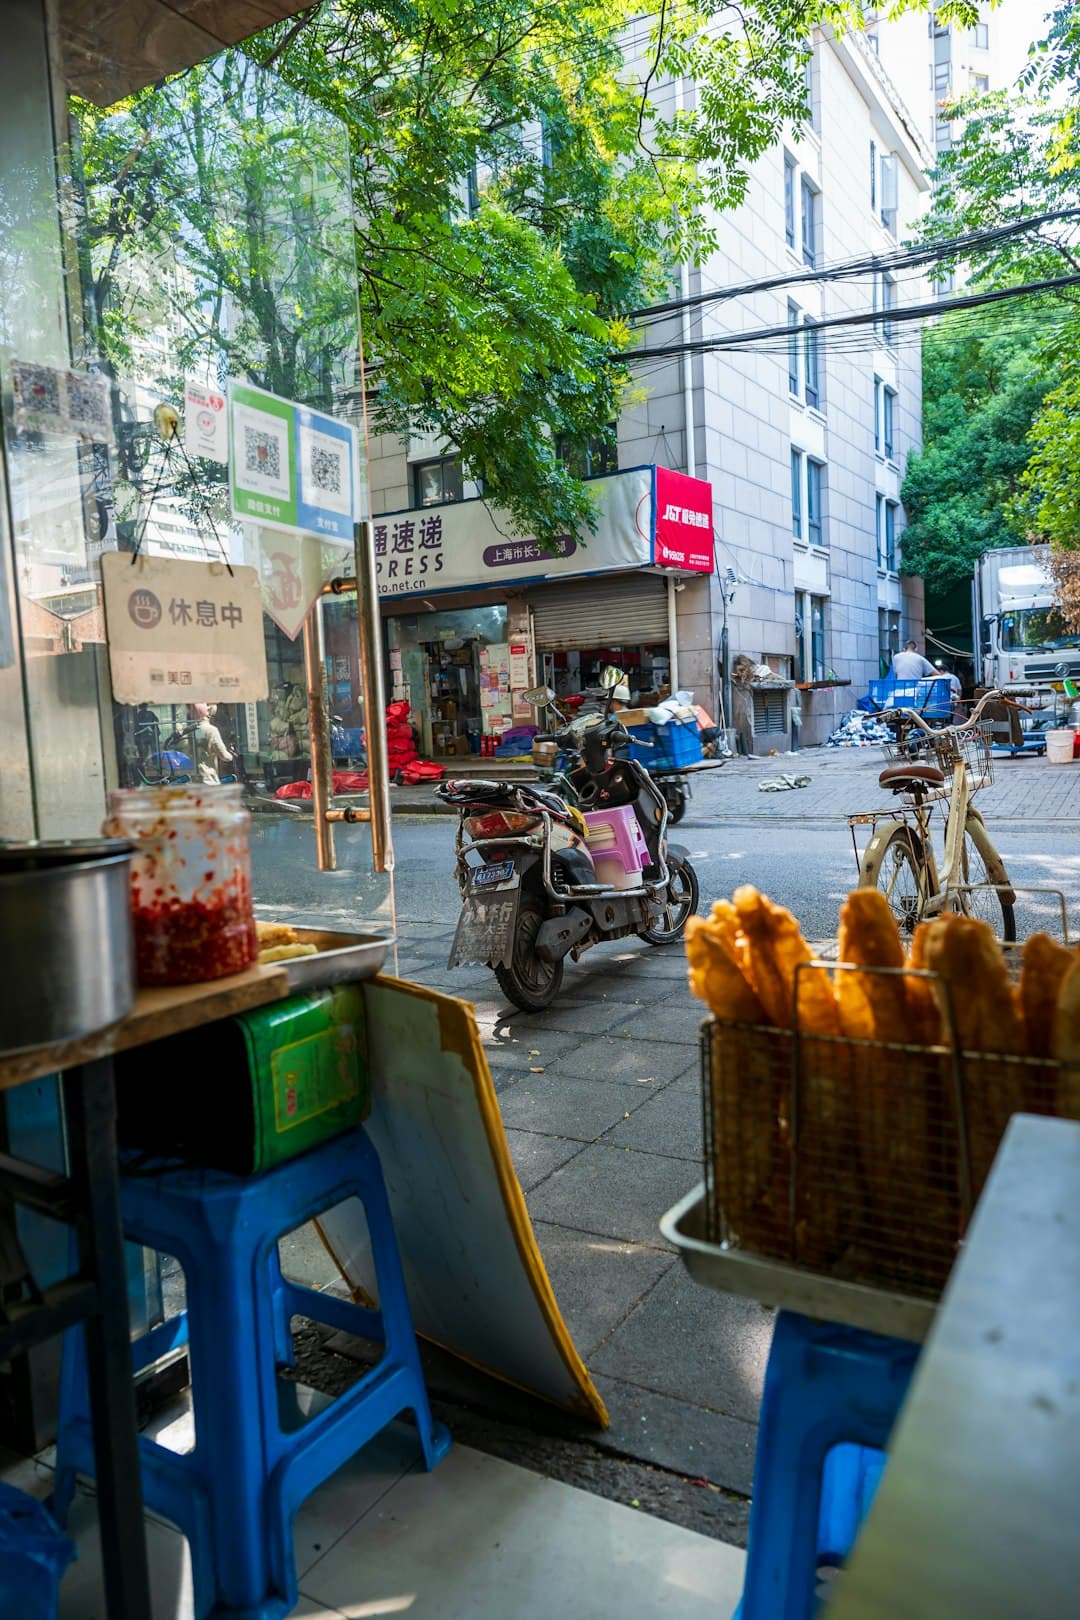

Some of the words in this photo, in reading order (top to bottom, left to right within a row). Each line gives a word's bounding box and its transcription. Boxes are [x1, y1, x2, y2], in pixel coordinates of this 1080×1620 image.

[374, 515, 443, 557] 通速递
[168, 598, 243, 629] 休息中
